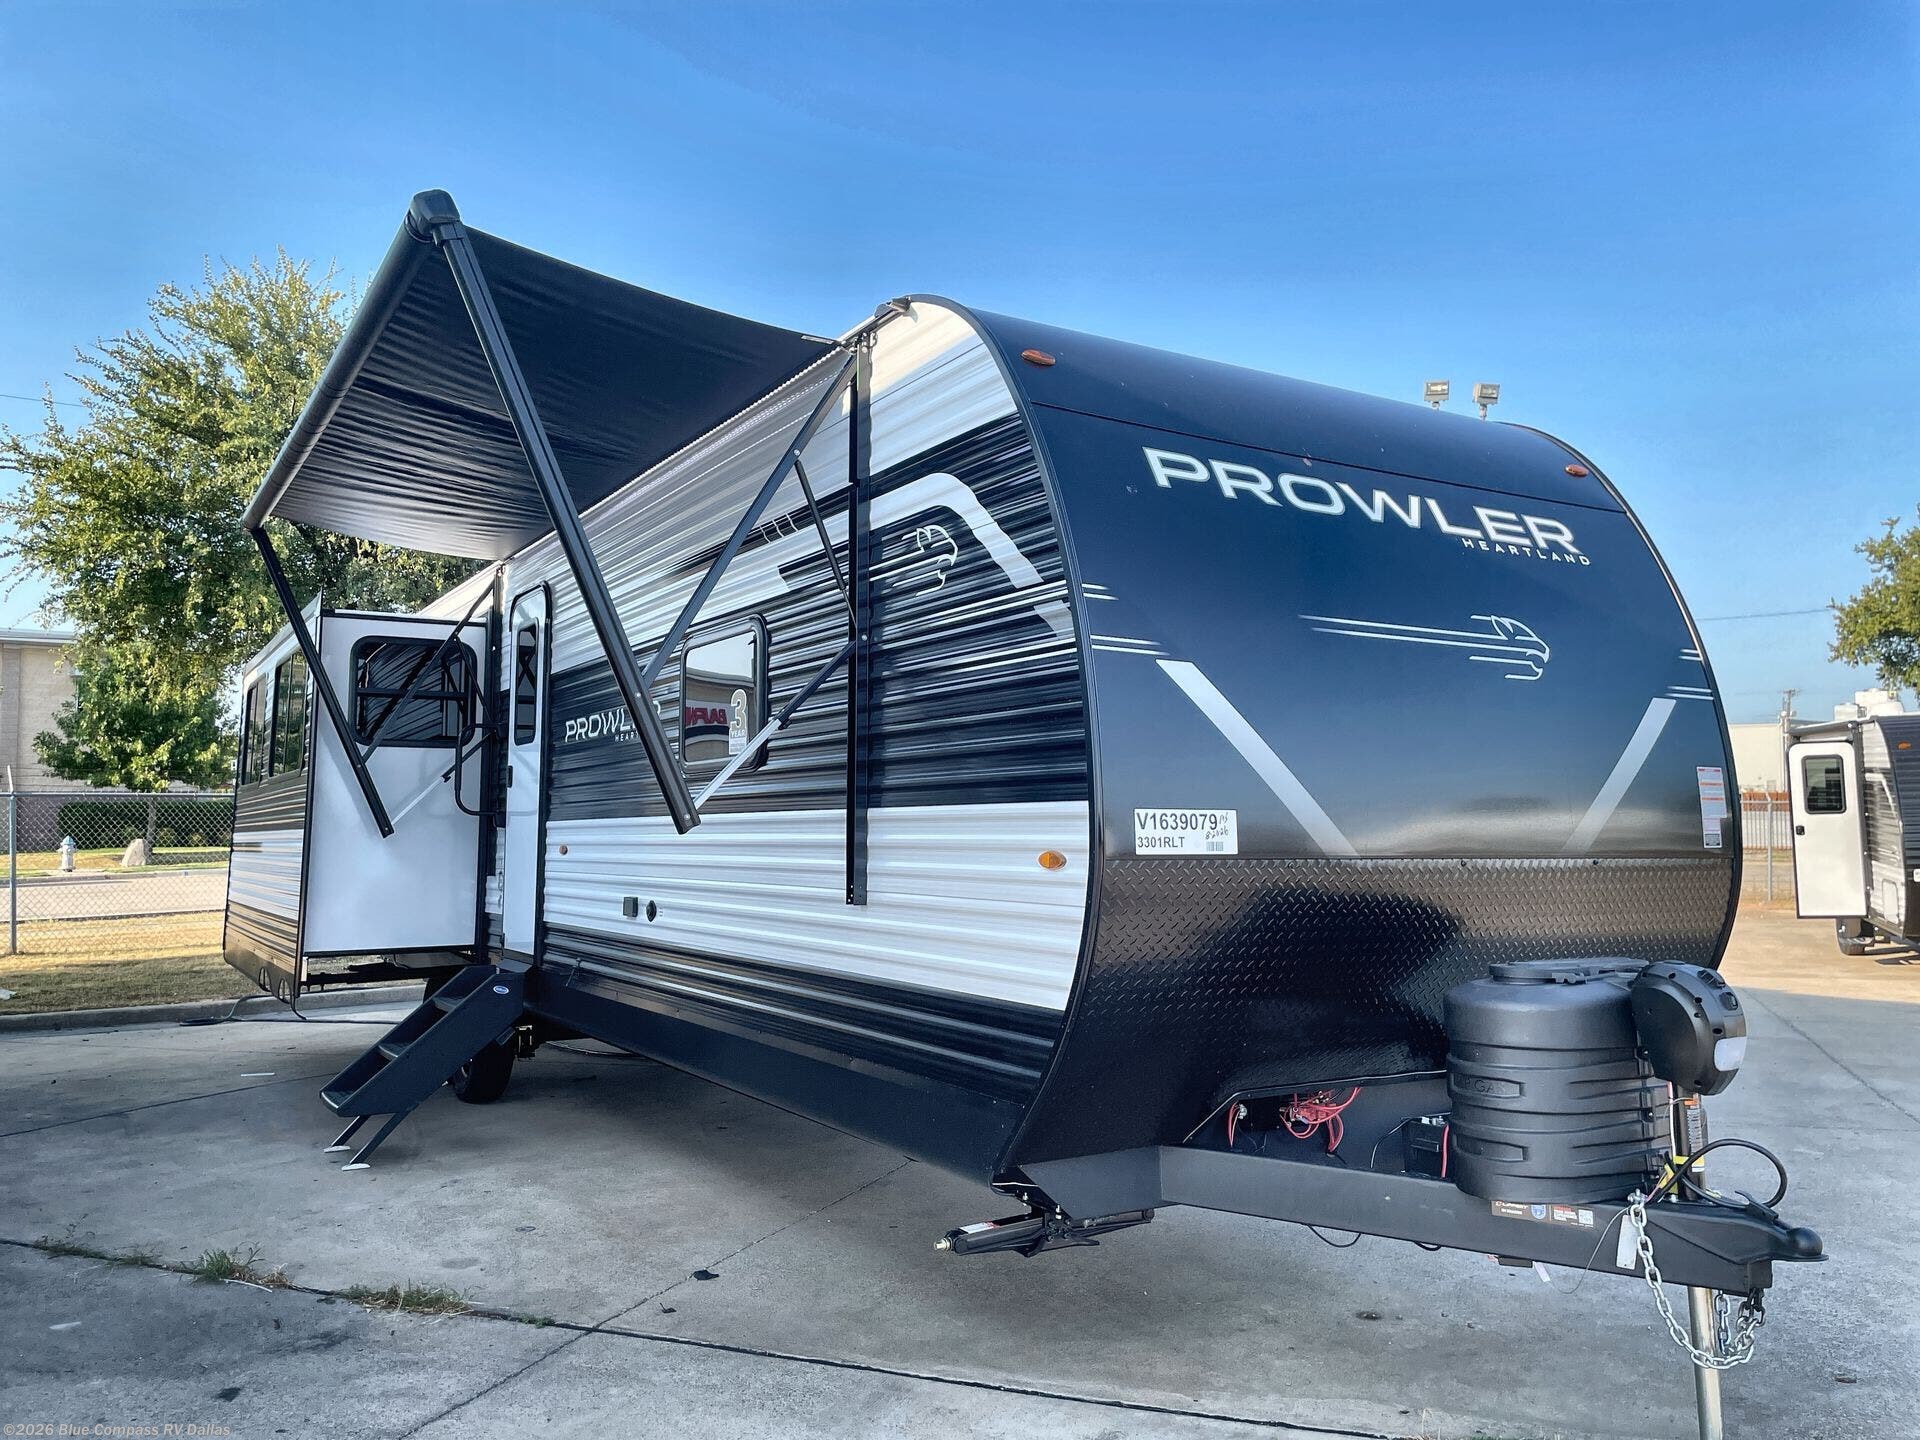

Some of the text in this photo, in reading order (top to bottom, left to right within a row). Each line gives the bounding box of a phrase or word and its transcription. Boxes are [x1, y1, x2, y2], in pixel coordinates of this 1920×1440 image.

[1142, 446, 1584, 555] PROWLER
[1461, 538, 1592, 566] HEARTLAND
[730, 688, 747, 730] 3
[1136, 812, 1218, 830] V1639079
[1137, 836, 1185, 848] 3301RLT
